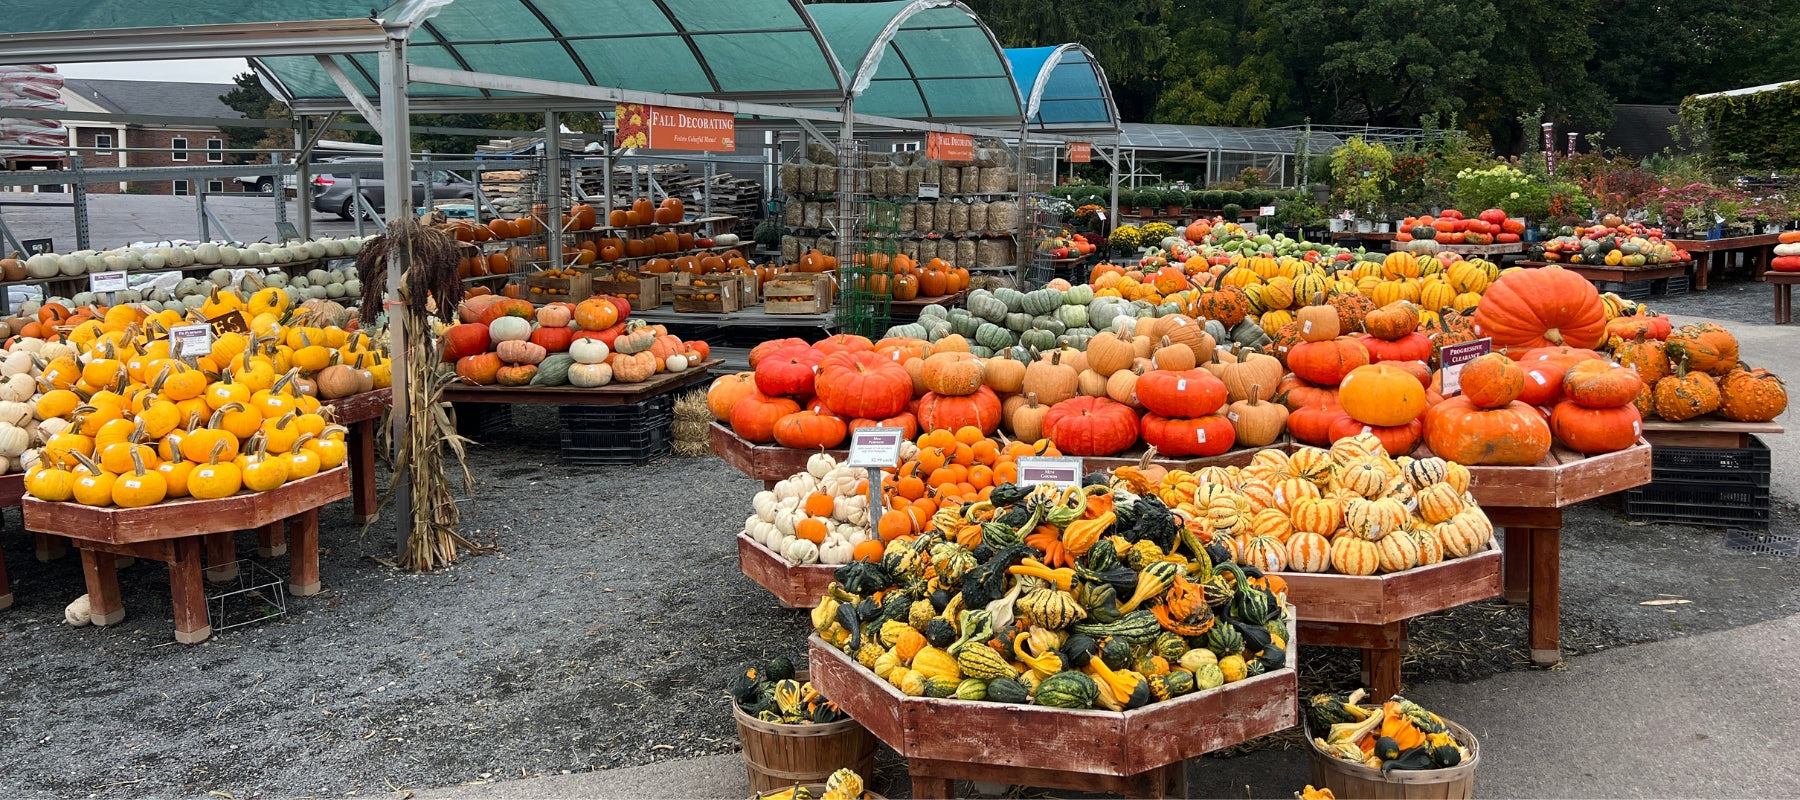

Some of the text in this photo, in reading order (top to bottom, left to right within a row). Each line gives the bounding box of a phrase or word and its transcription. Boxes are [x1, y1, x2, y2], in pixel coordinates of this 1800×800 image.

[652, 111, 733, 130] FALL DECORATING
[1450, 345, 1482, 355] PROGRESSIVE
